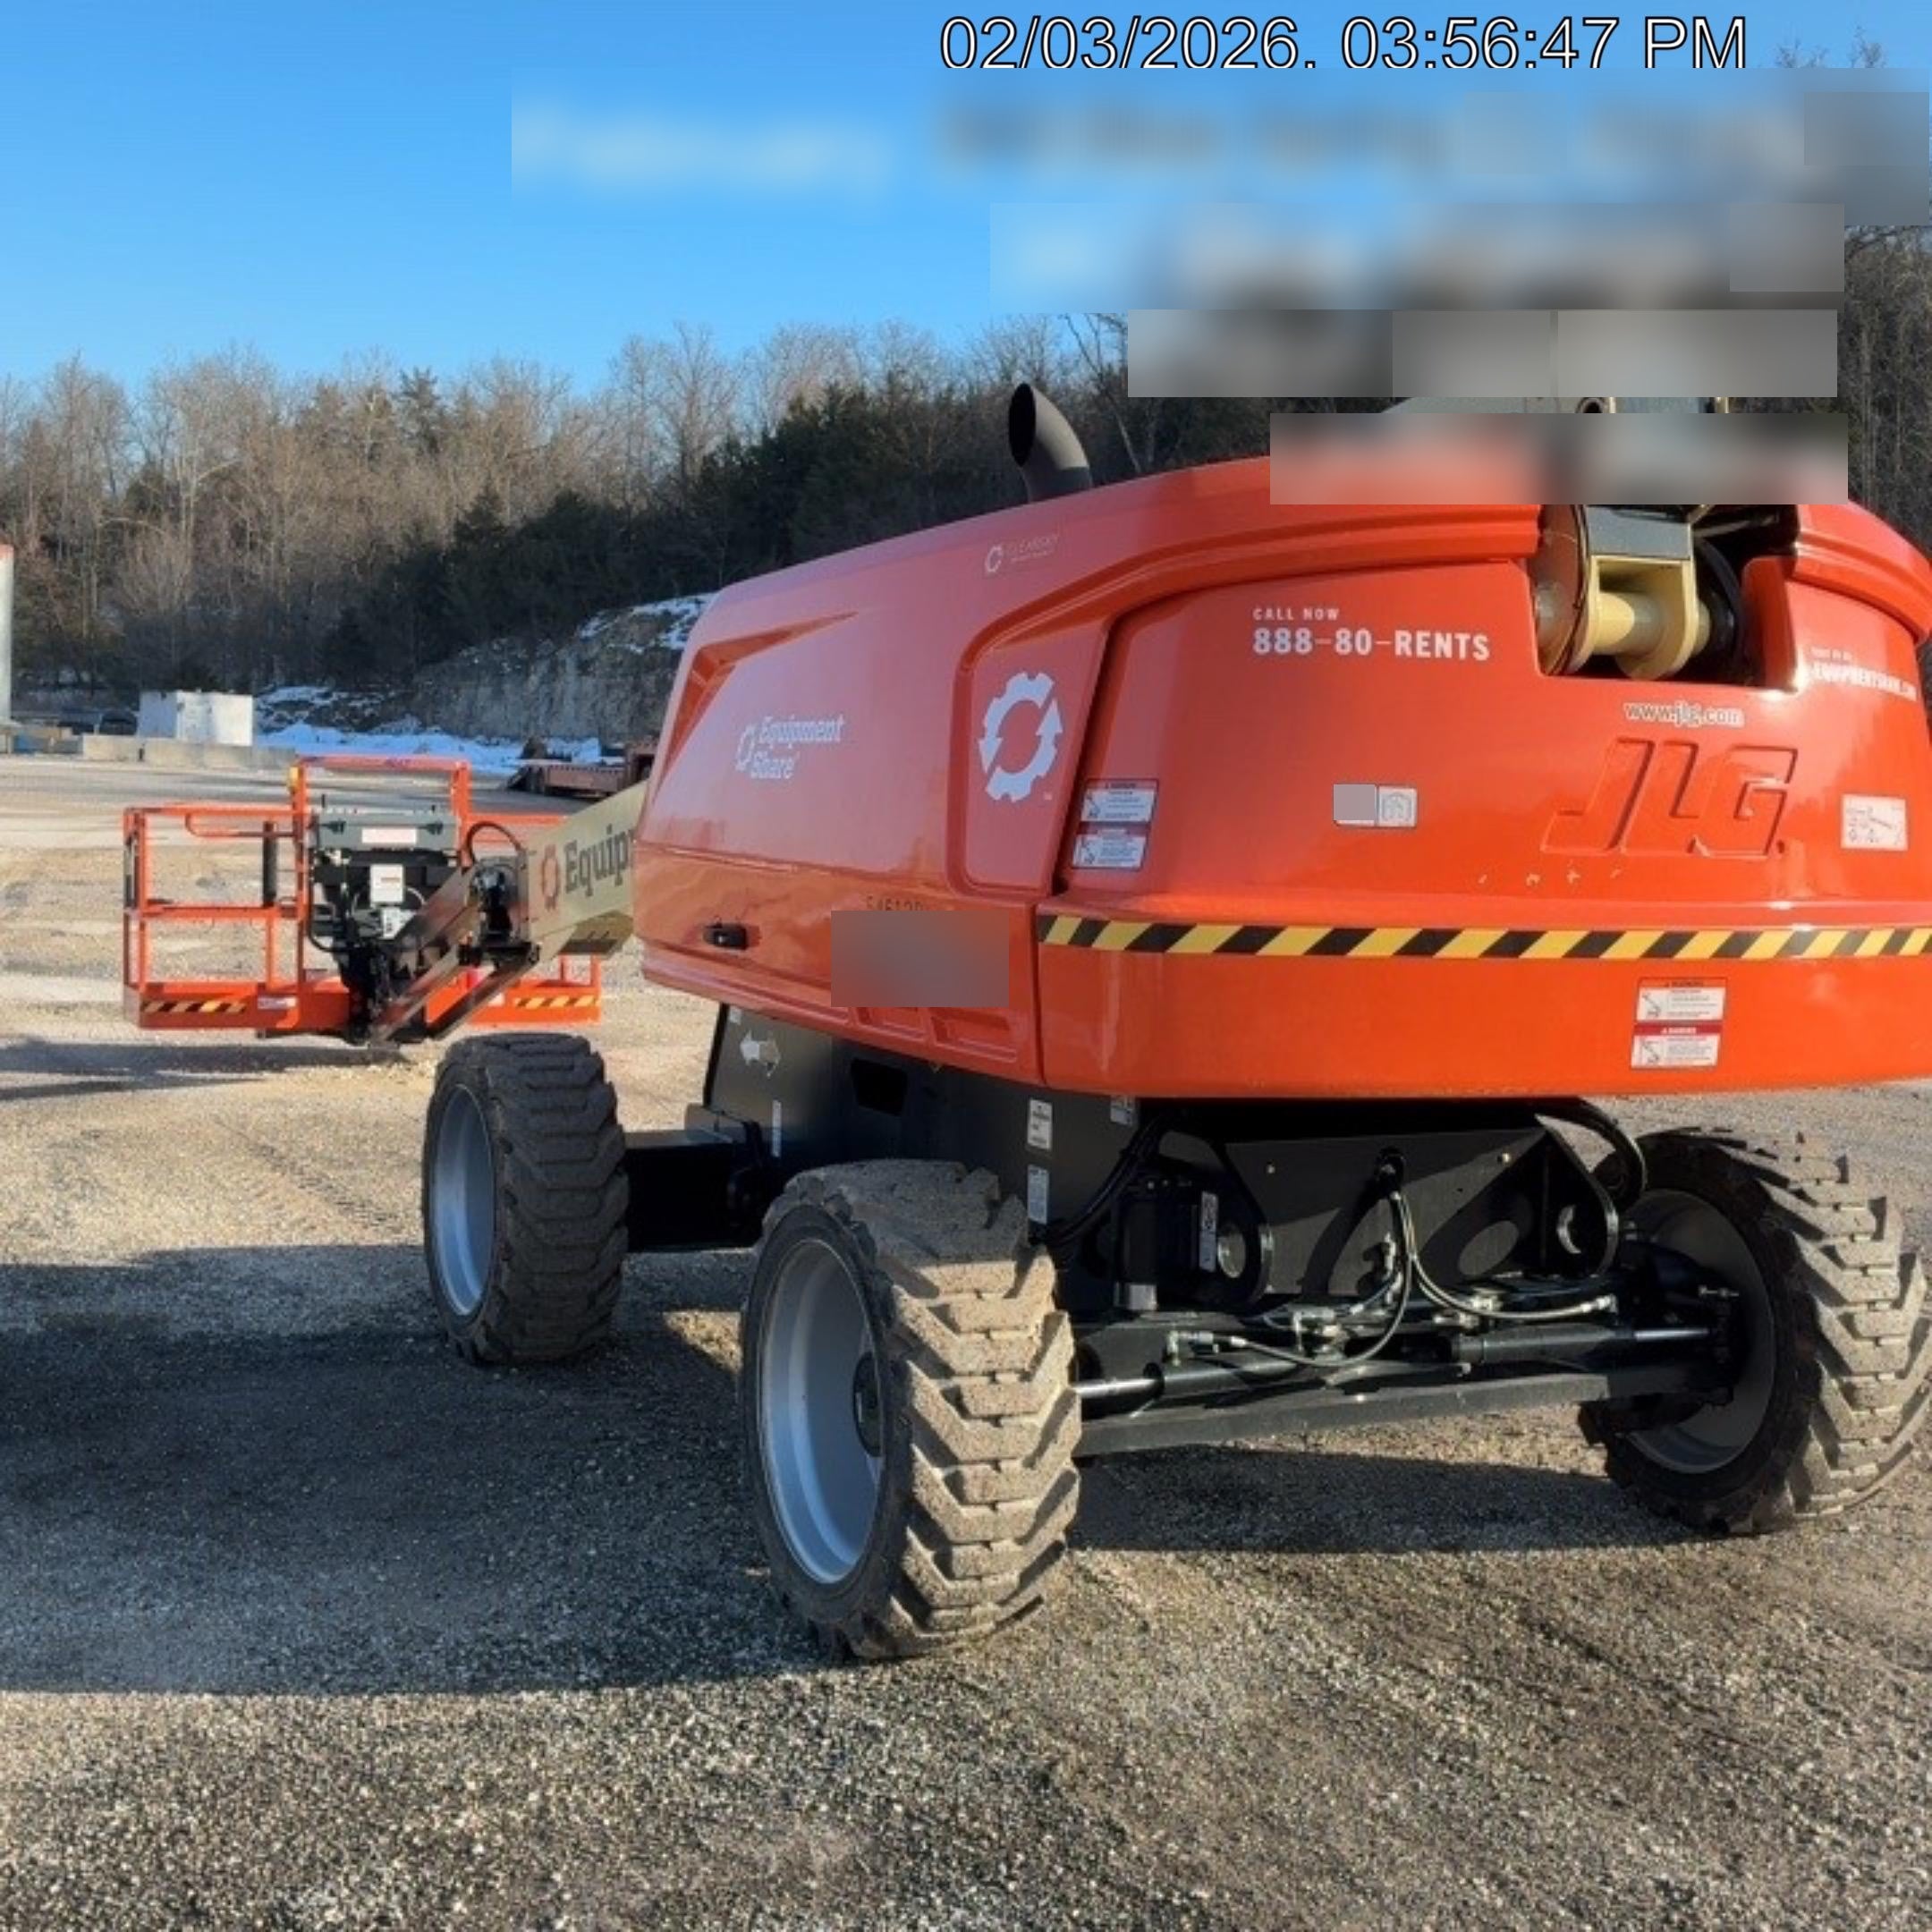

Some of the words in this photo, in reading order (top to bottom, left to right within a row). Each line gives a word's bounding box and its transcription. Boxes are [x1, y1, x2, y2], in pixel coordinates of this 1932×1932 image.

[1252, 607, 1294, 621] CALL
[1302, 608, 1340, 621] NOW
[1253, 627, 1491, 661] 888-80-RENTS
[1539, 736, 1798, 859] JLG
